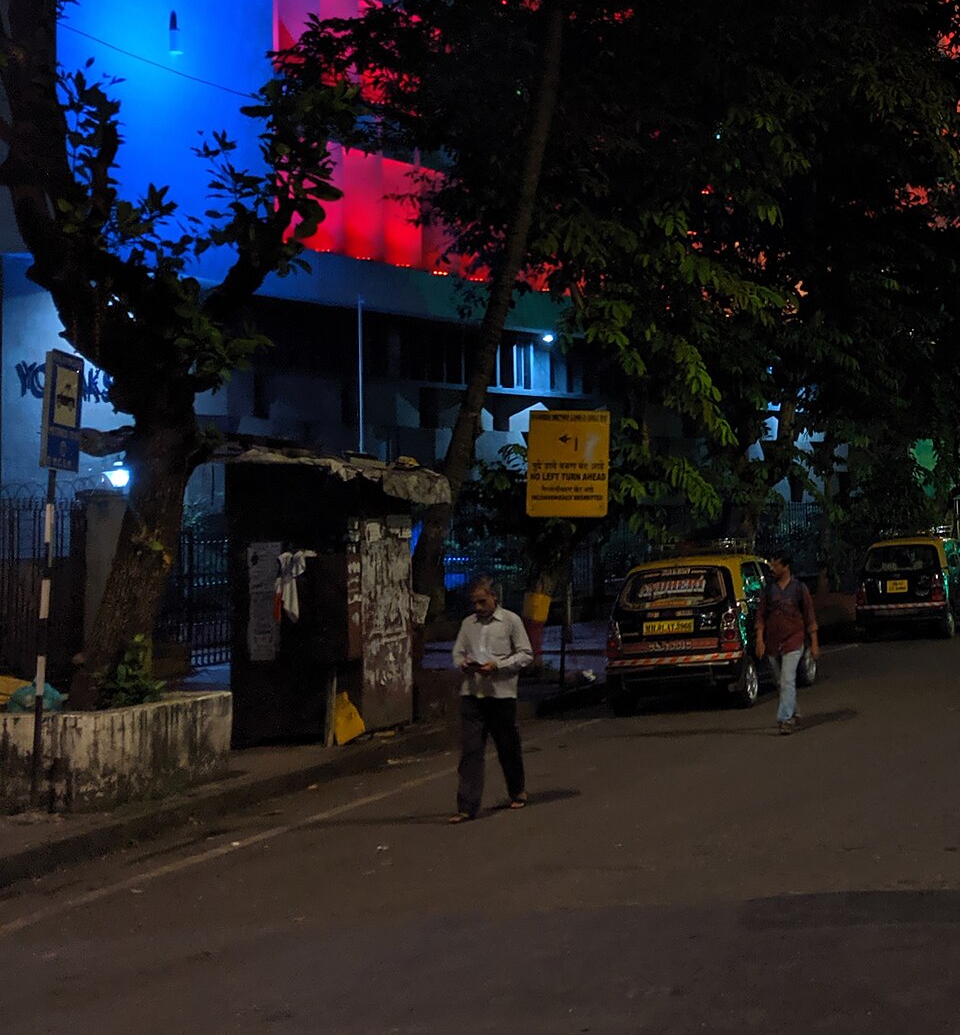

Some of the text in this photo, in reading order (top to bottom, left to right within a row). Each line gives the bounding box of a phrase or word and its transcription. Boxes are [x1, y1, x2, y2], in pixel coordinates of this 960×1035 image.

[531, 473, 606, 481] NO LEFT TURN AHEAD
